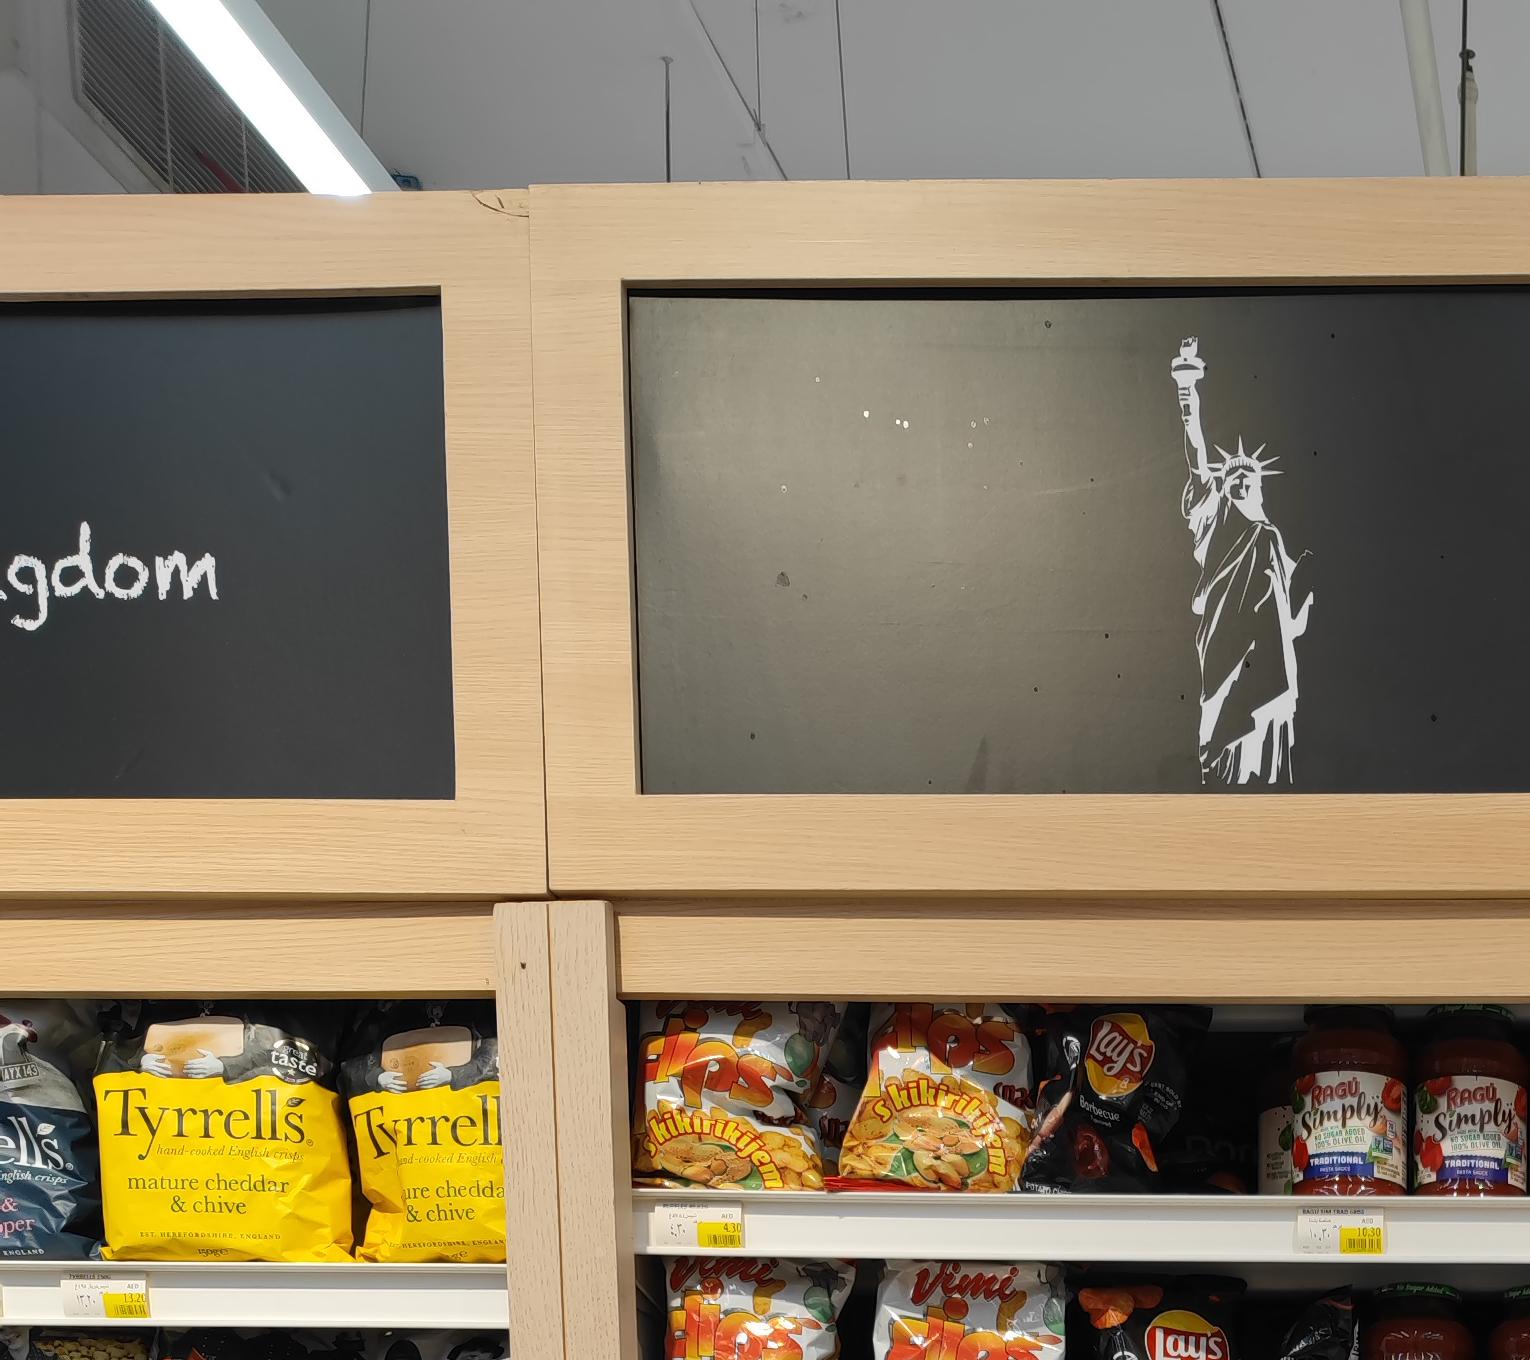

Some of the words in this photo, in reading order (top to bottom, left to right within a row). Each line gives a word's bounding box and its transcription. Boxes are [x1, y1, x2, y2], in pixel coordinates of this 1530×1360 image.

[0, 521, 219, 631] gdom
[270, 1048, 317, 1076] taste
[1311, 1078, 1360, 1109] RAGÚ
[1301, 1096, 1382, 1138] Simply
[1310, 1157, 1363, 1165] TRADITIONAL
[1445, 1159, 1500, 1169] TRADITIONAL
[128, 1176, 198, 1194] mature
[205, 1175, 289, 1192] cheddar
[191, 1198, 247, 1215] chive
[406, 1204, 422, 1221] &
